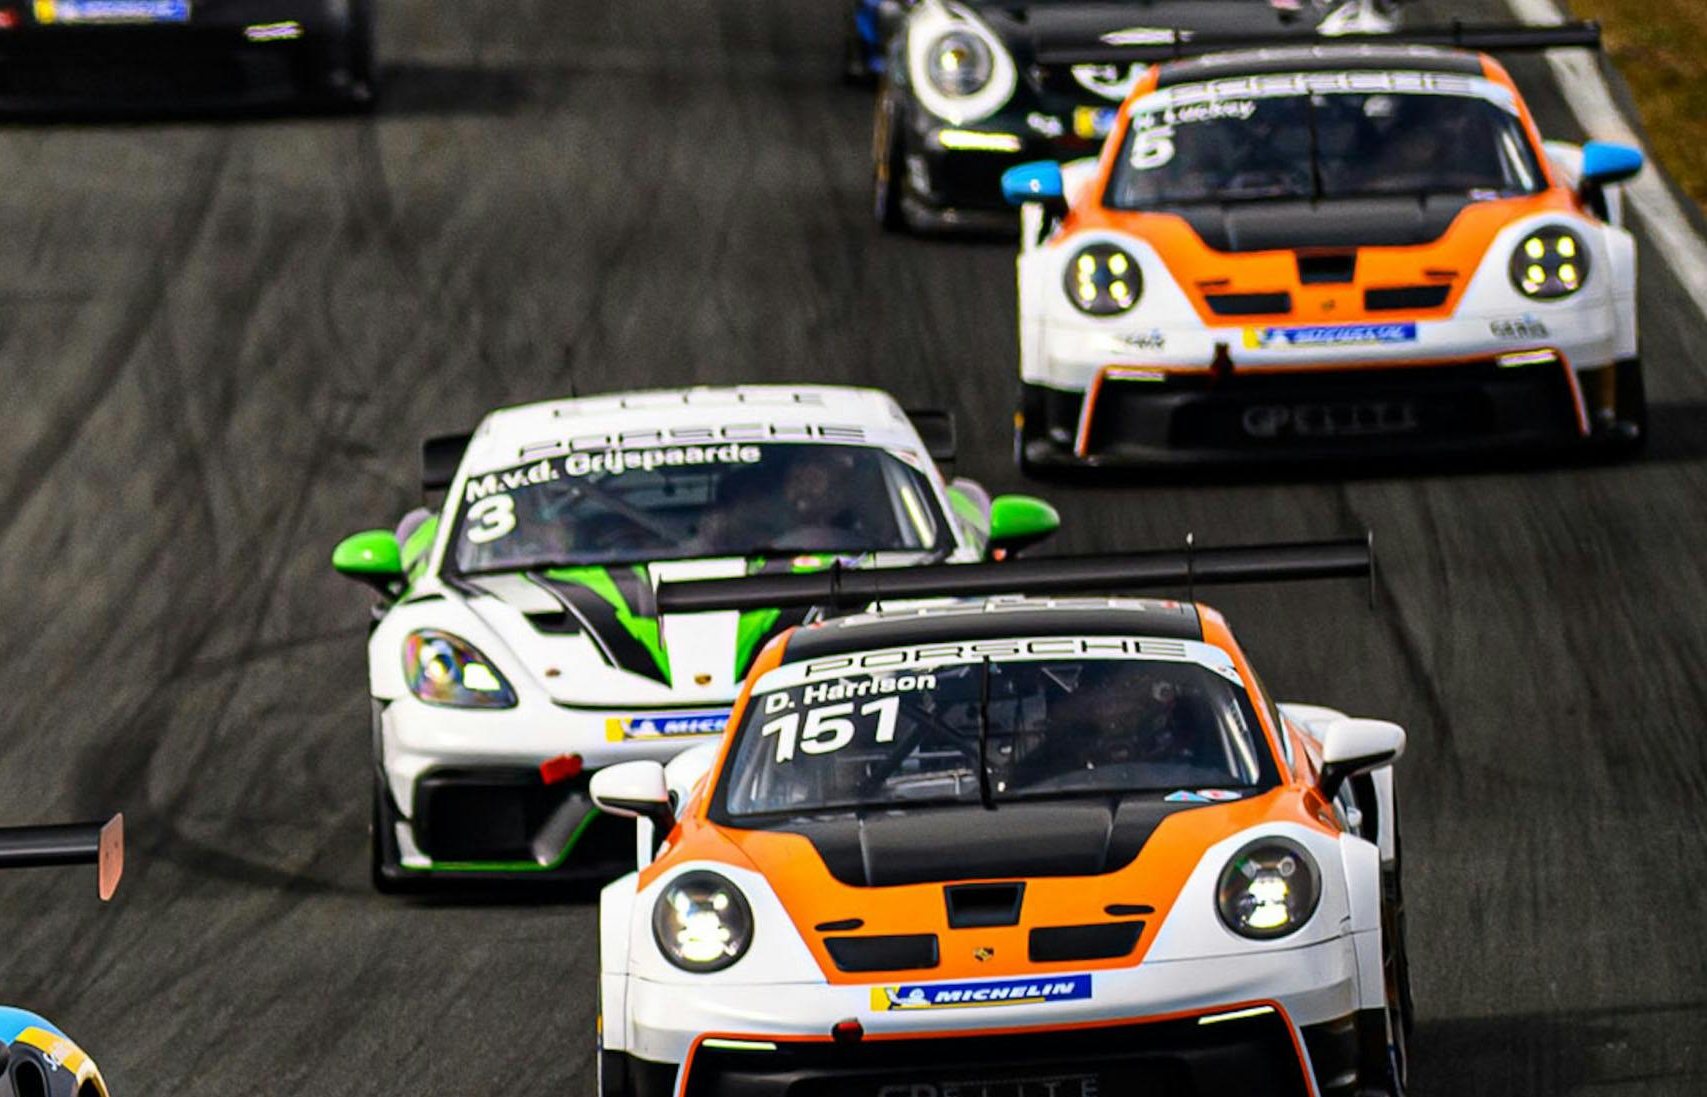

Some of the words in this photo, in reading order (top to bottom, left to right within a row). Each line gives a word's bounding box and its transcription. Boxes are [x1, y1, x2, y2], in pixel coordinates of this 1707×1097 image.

[1130, 126, 1175, 169] 5
[519, 424, 866, 457] PORSCHE
[564, 443, 762, 476] Grijspaarde
[466, 493, 517, 544] 3
[806, 639, 1186, 676] PORSCHE
[765, 693, 796, 715] D.
[804, 673, 936, 707] Harrison
[762, 696, 901, 763] 151
[934, 982, 1075, 1003] MICHELIN
